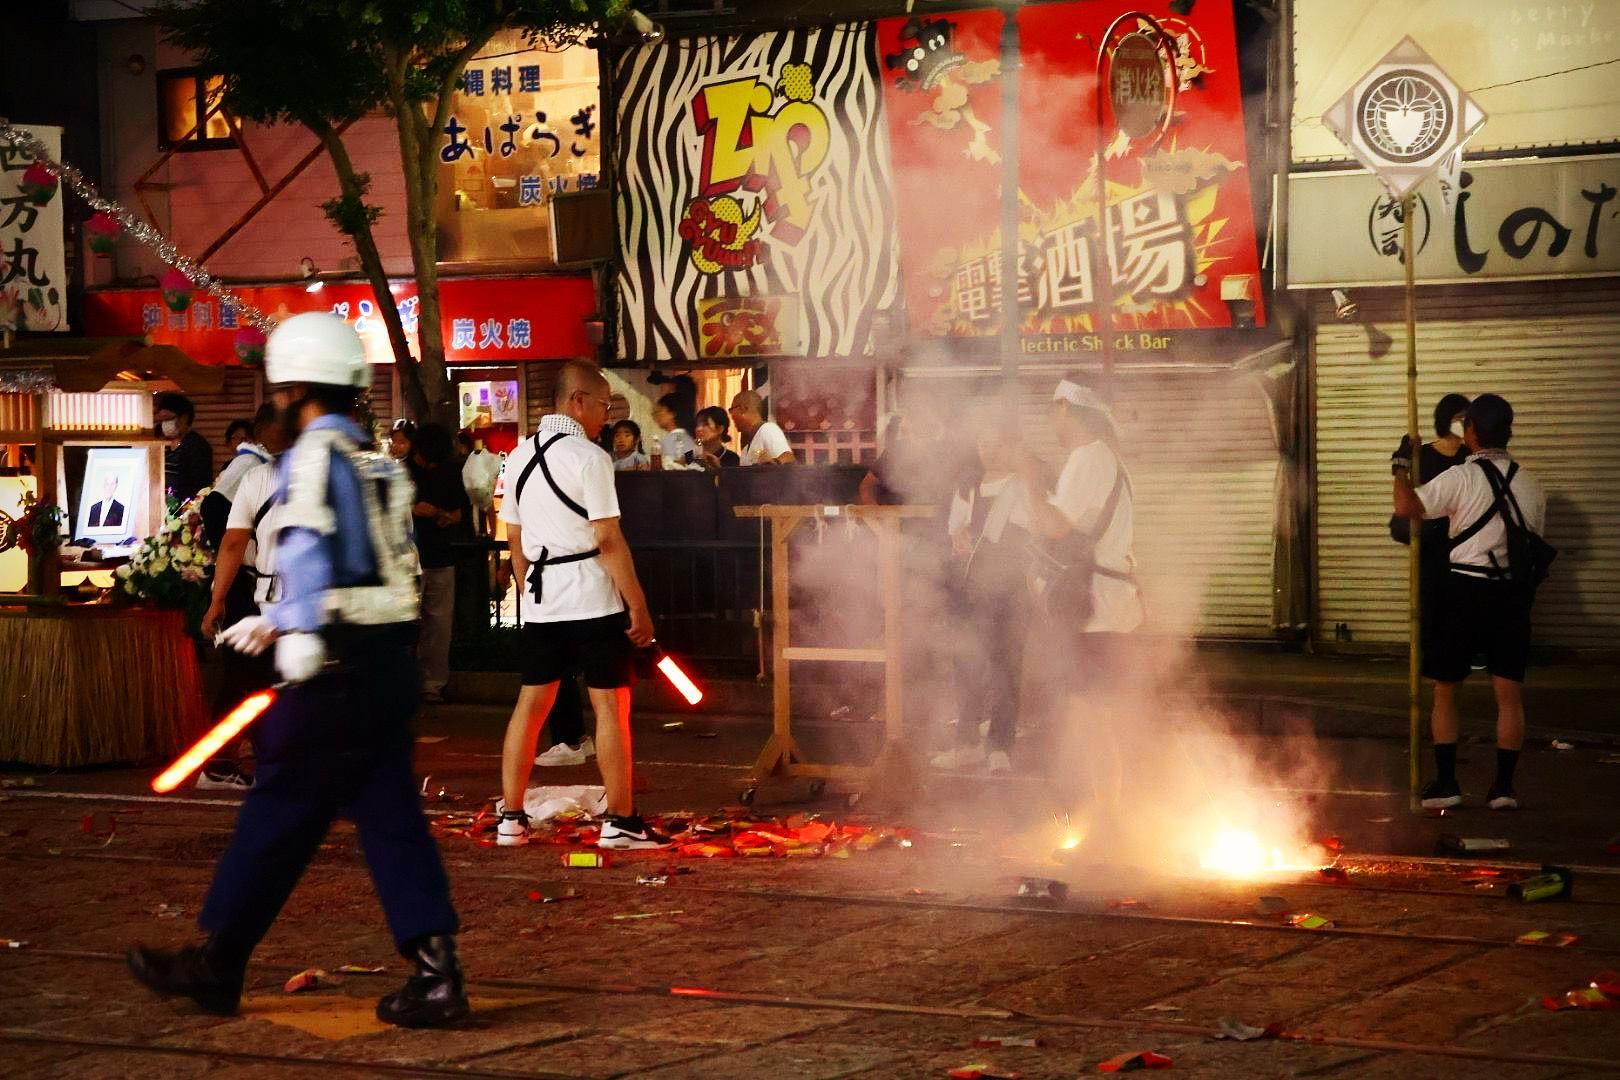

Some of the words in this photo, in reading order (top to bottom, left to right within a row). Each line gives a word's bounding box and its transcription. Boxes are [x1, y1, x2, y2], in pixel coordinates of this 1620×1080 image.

[441, 105, 596, 162] あぱらぎ
[452, 318, 530, 349] 炭火焼
[1020, 336, 1079, 353] lectric
[1081, 335, 1134, 352] Shck
[1140, 333, 1171, 350] Bar
